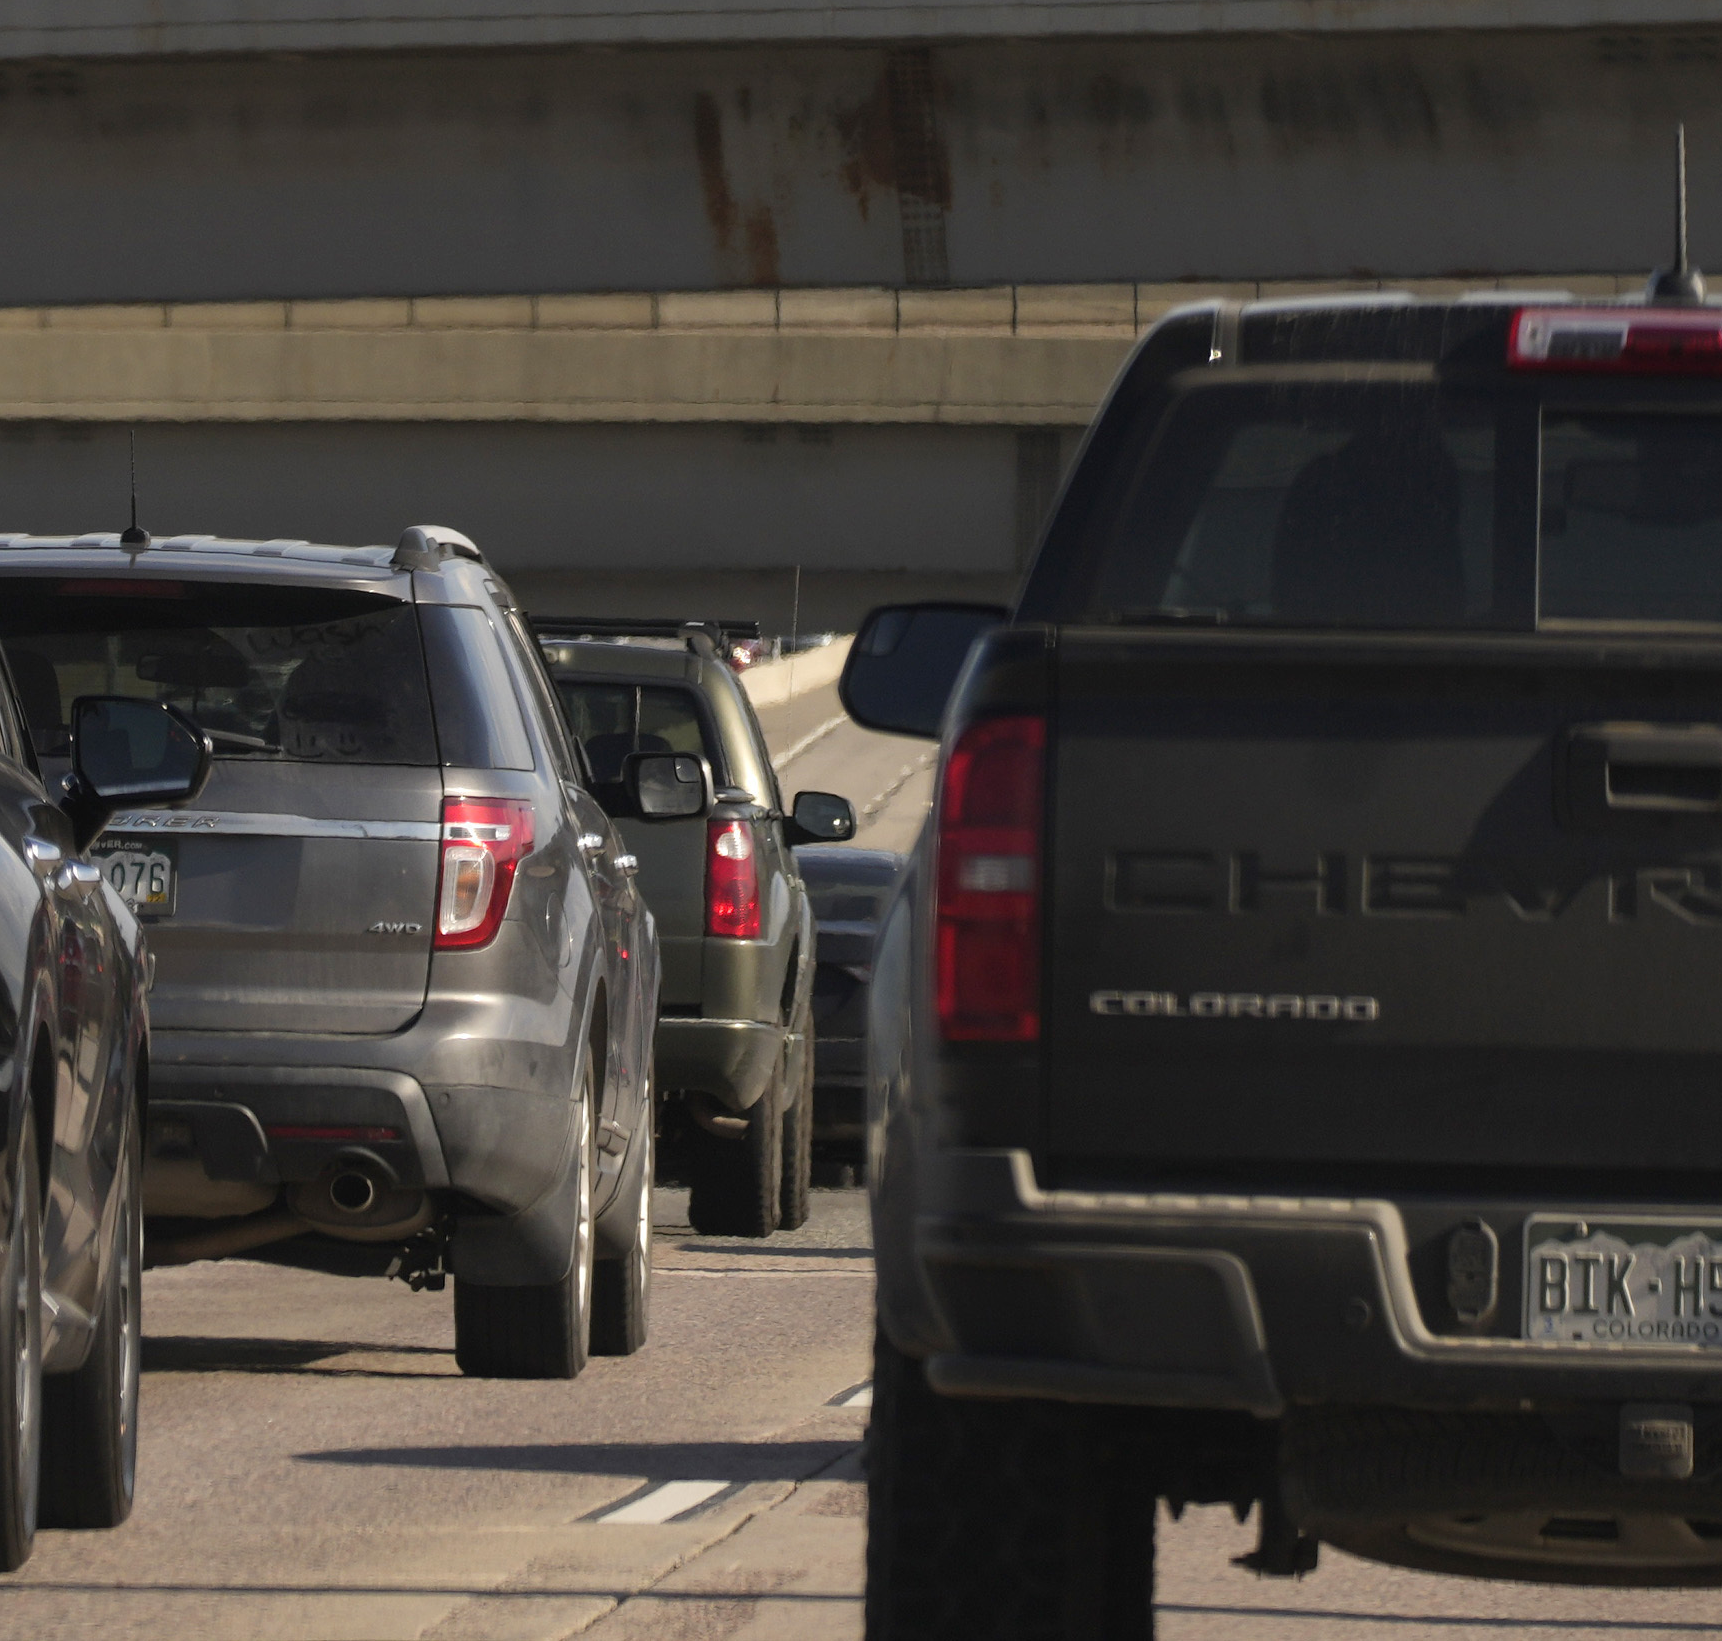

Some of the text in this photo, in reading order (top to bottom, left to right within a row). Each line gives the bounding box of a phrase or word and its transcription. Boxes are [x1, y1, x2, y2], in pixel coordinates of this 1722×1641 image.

[366, 921, 422, 934] 4WD
[1089, 990, 1379, 1021] COLORADO
[1592, 1318, 1720, 1340] COLORADO
